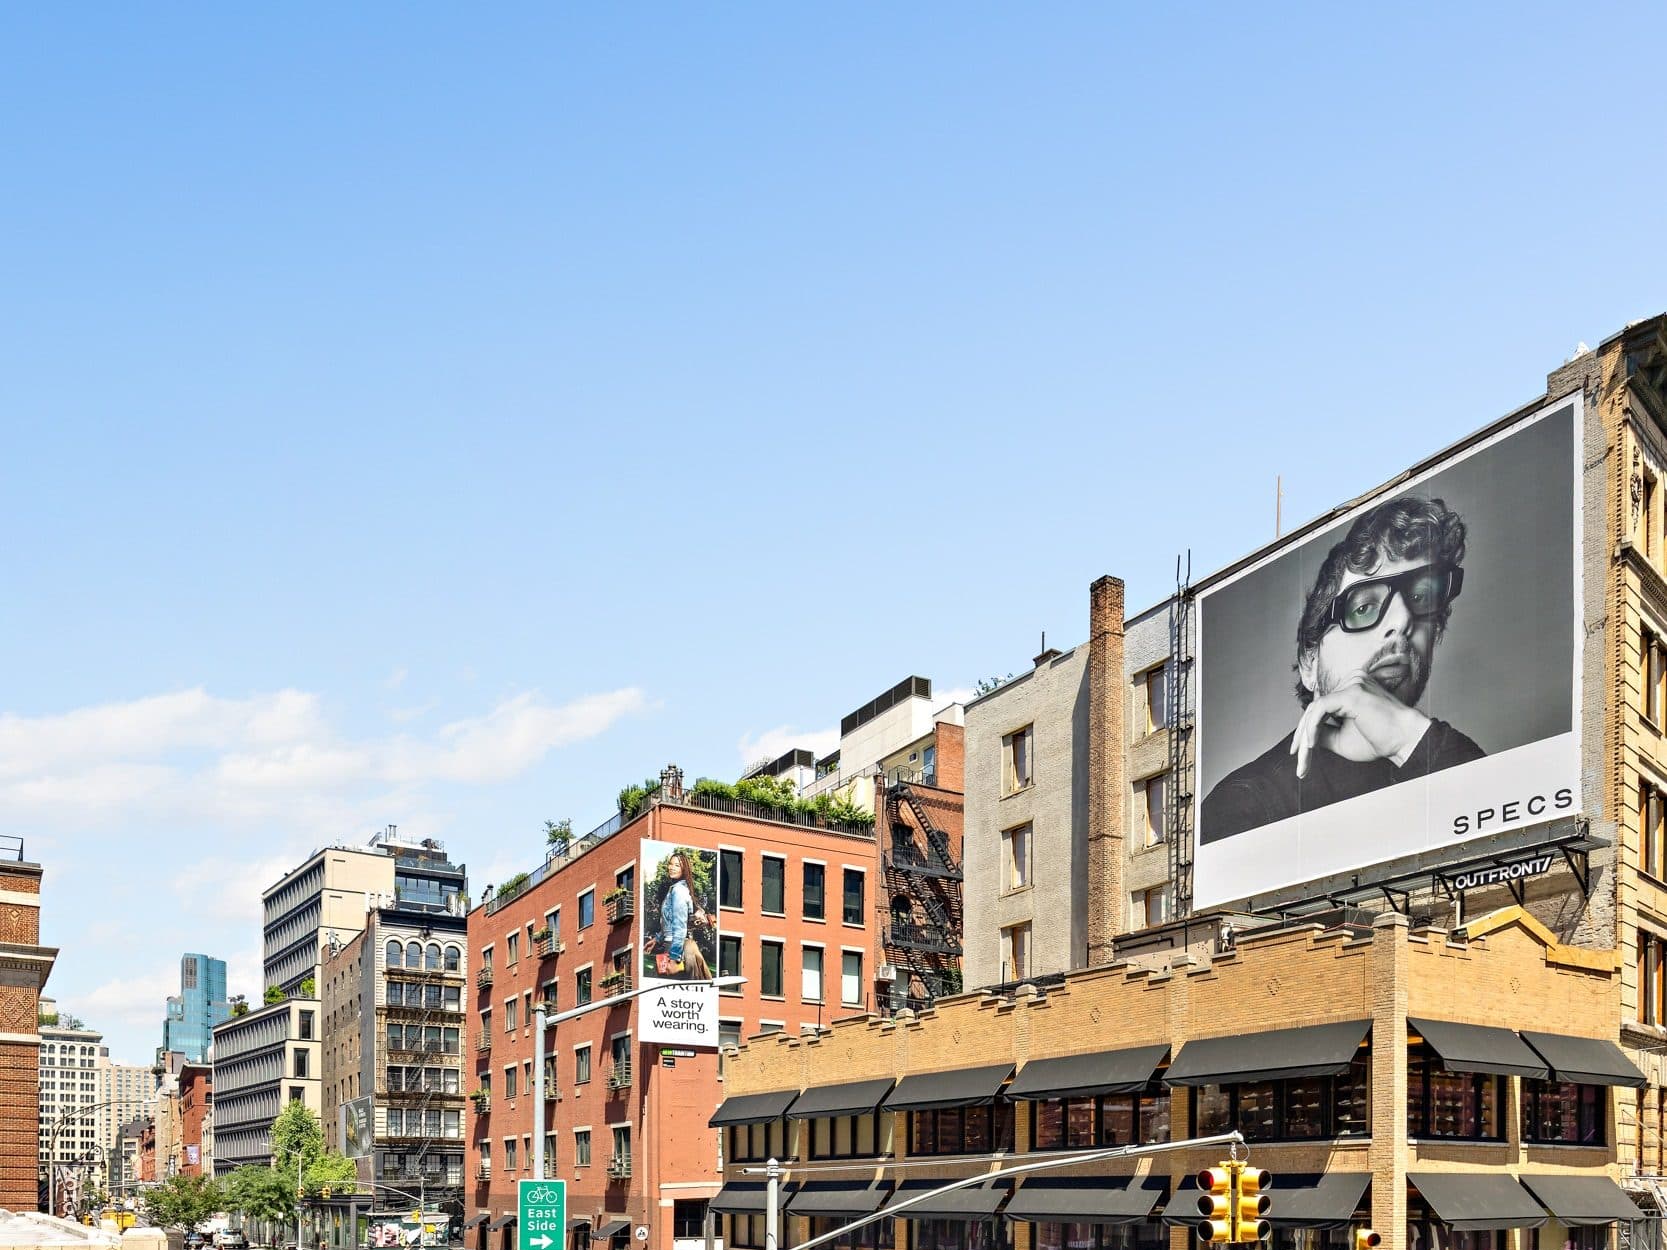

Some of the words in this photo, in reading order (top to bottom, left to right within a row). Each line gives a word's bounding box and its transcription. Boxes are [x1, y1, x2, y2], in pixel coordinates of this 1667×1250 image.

[1453, 788, 1573, 835] SPECS
[656, 996, 667, 1007] A
[670, 999, 704, 1012] story
[661, 1009, 700, 1020] worth
[652, 1020, 709, 1034] wearing.
[527, 1208, 557, 1218] East
[527, 1220, 557, 1231] Side
